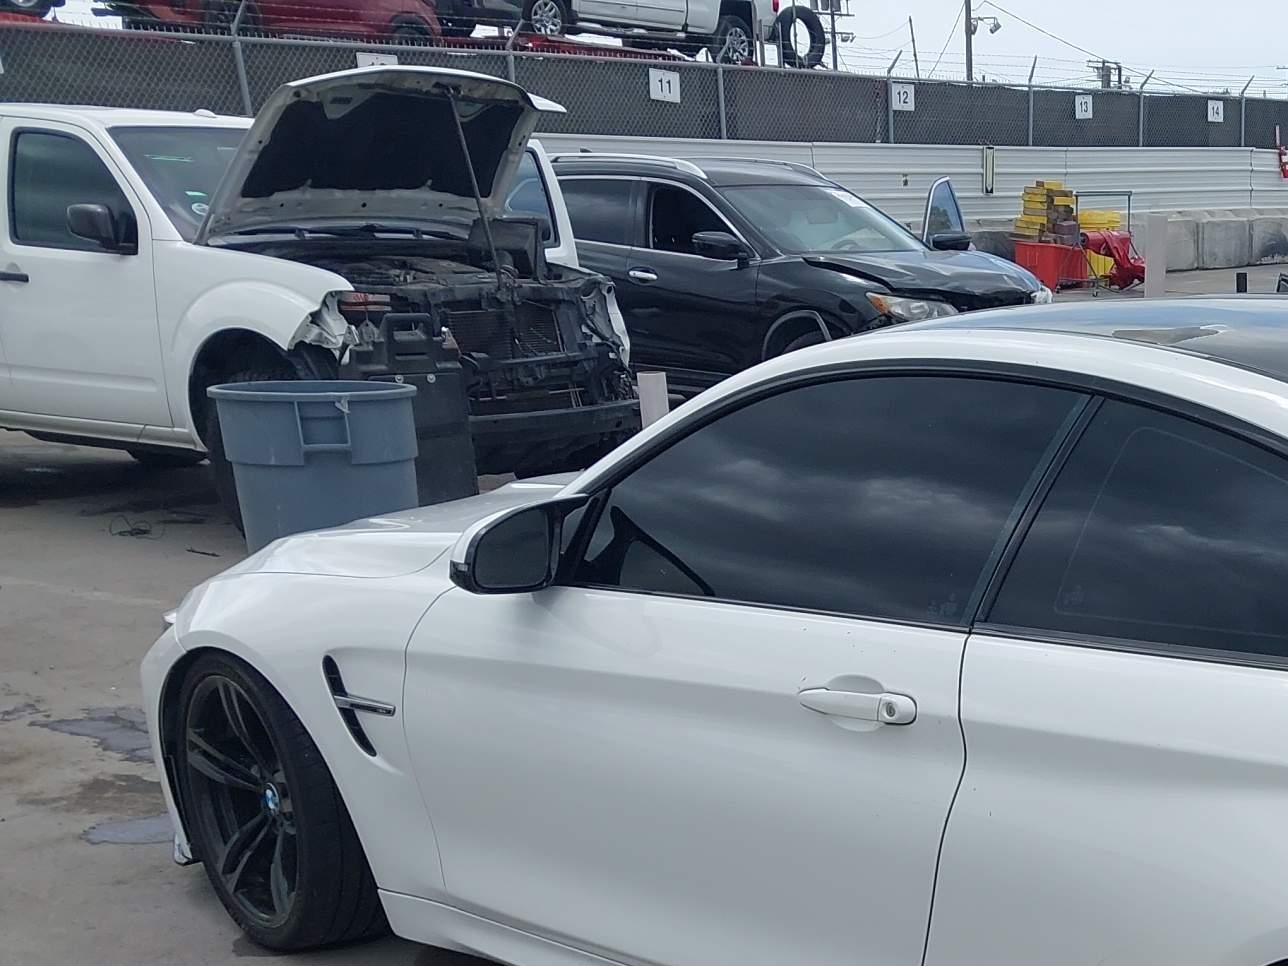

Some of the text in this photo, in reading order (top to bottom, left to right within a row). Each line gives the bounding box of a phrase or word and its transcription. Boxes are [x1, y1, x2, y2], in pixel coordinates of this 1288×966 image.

[658, 77, 672, 94] 11
[896, 90, 909, 104] 12
[1080, 101, 1089, 113] 13
[1212, 105, 1220, 117] 14
